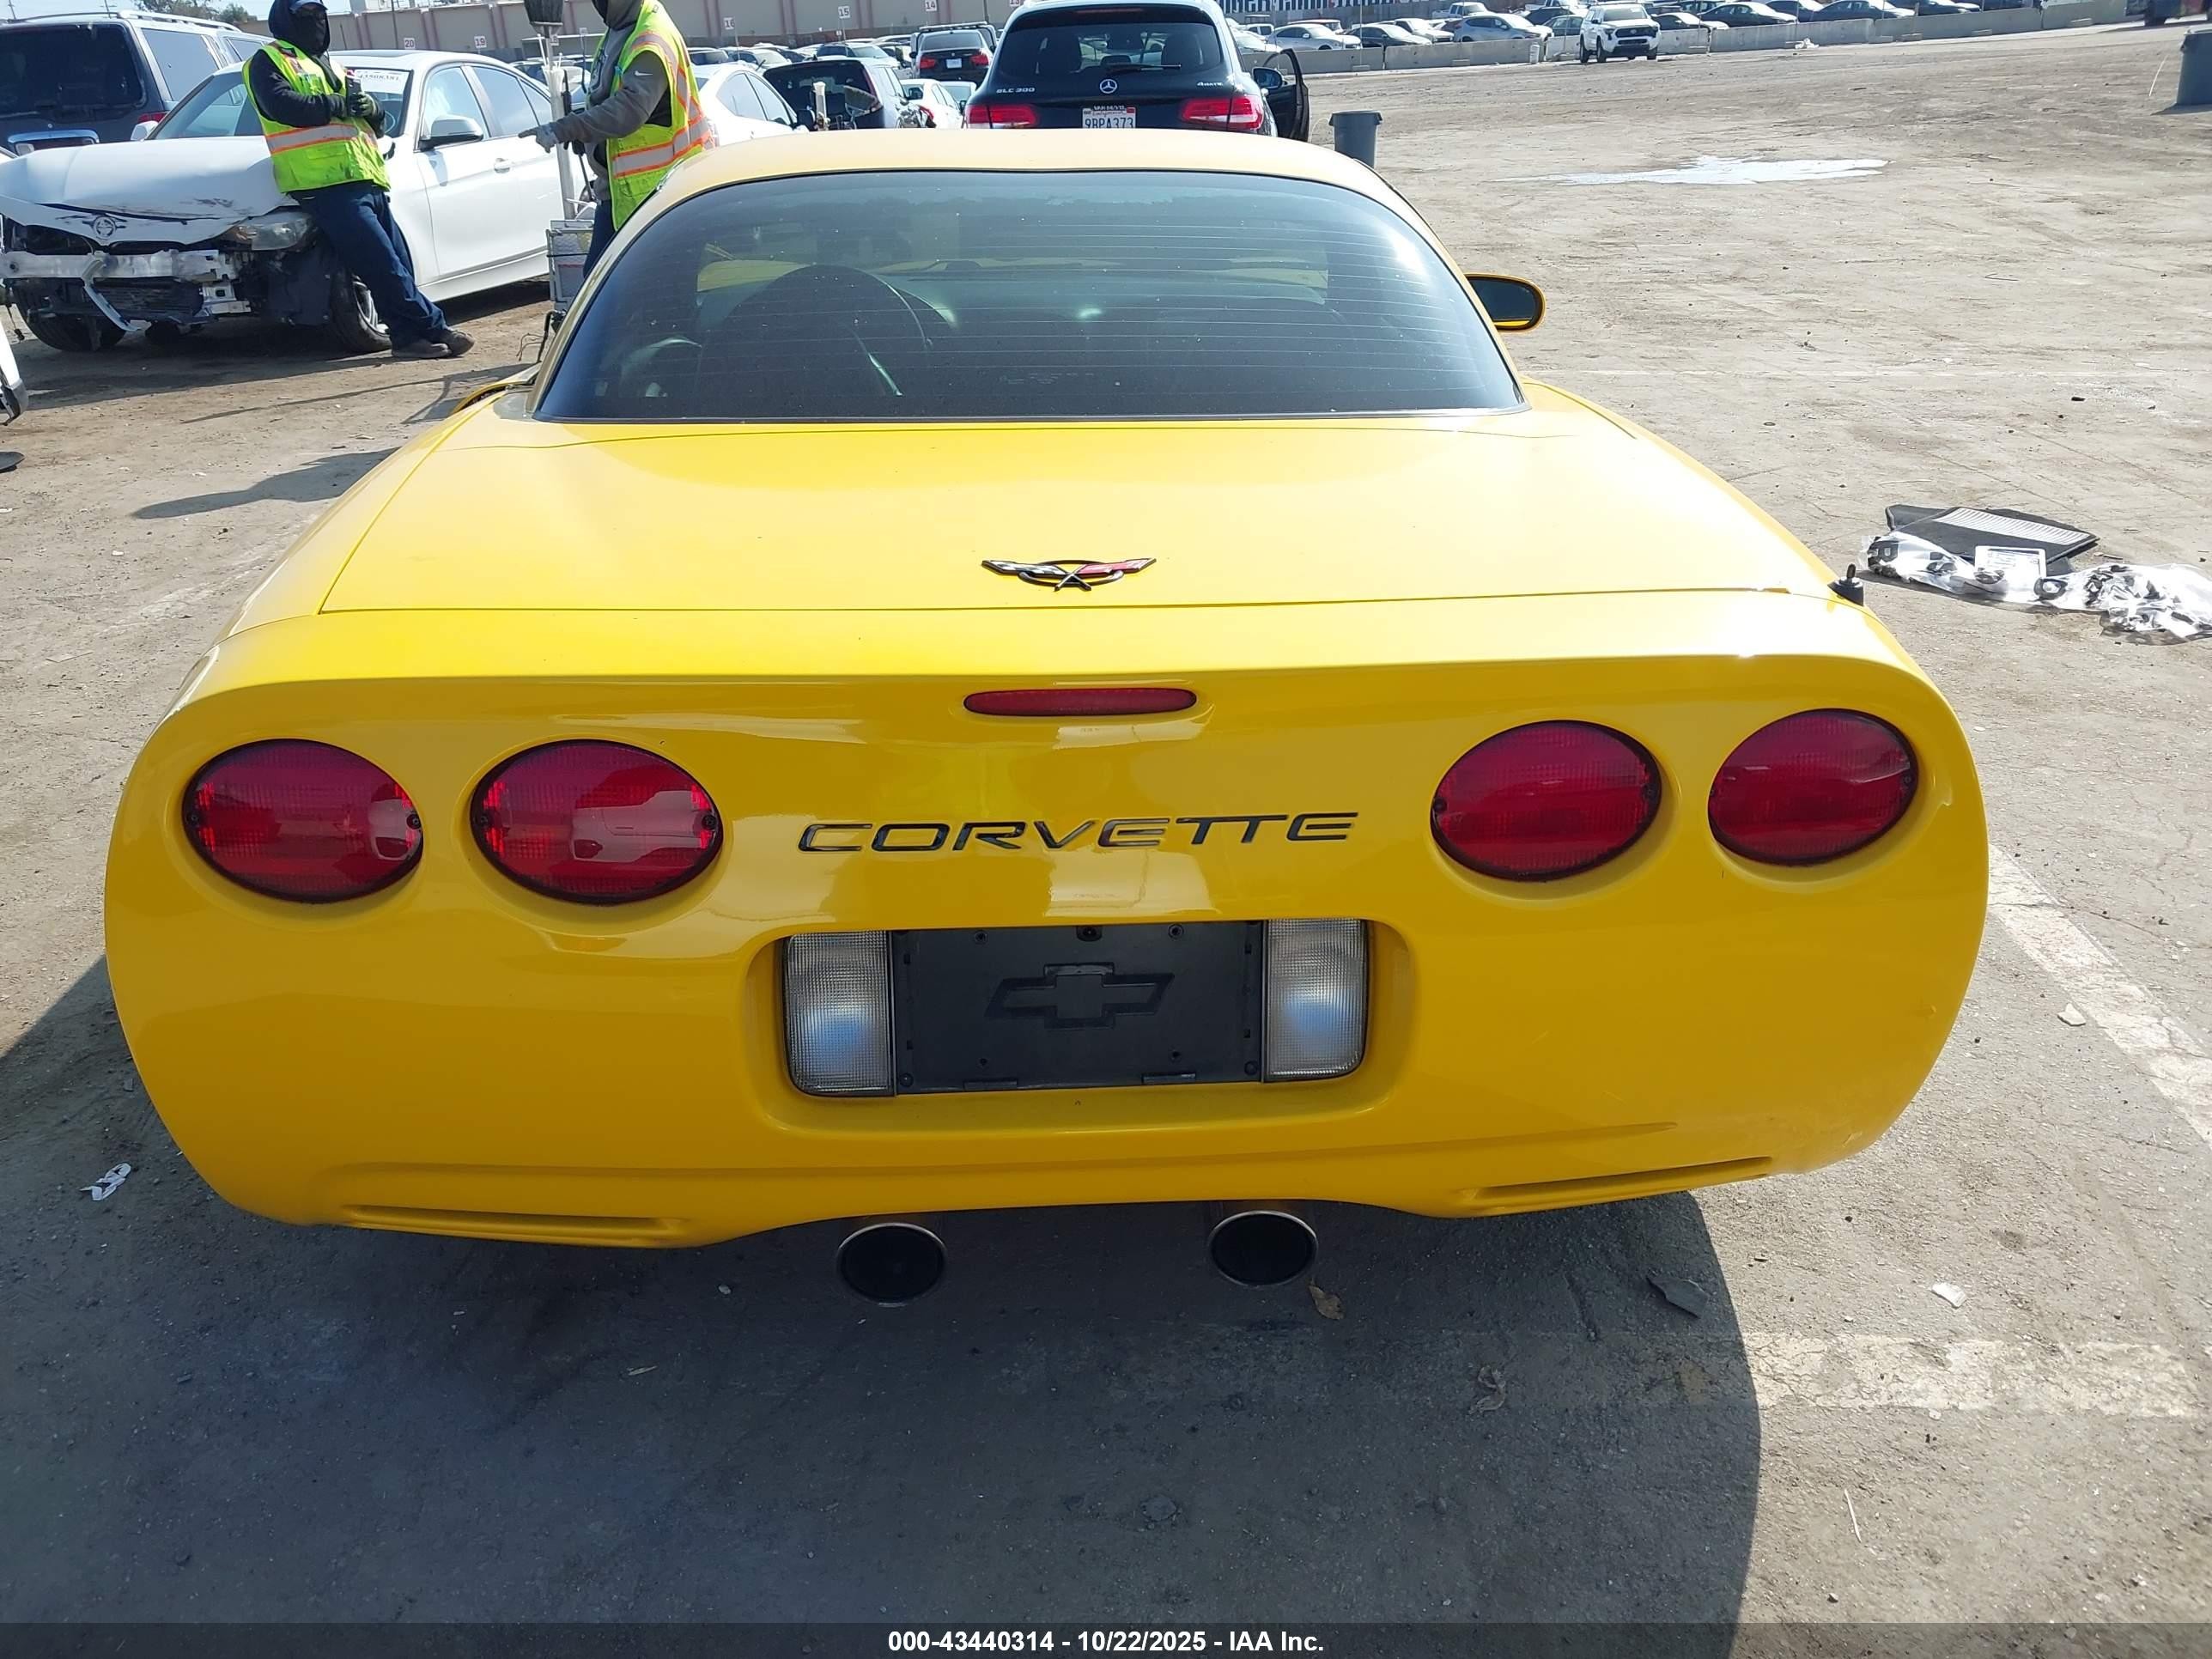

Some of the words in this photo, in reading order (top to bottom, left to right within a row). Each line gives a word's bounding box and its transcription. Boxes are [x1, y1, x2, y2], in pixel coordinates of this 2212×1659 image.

[927, 1, 936, 9] 14
[838, 8, 849, 16] 15
[725, 19, 735, 28] 16
[404, 39, 415, 48] 20
[475, 36, 486, 46] 19
[797, 811, 1358, 852] CORVETTE
